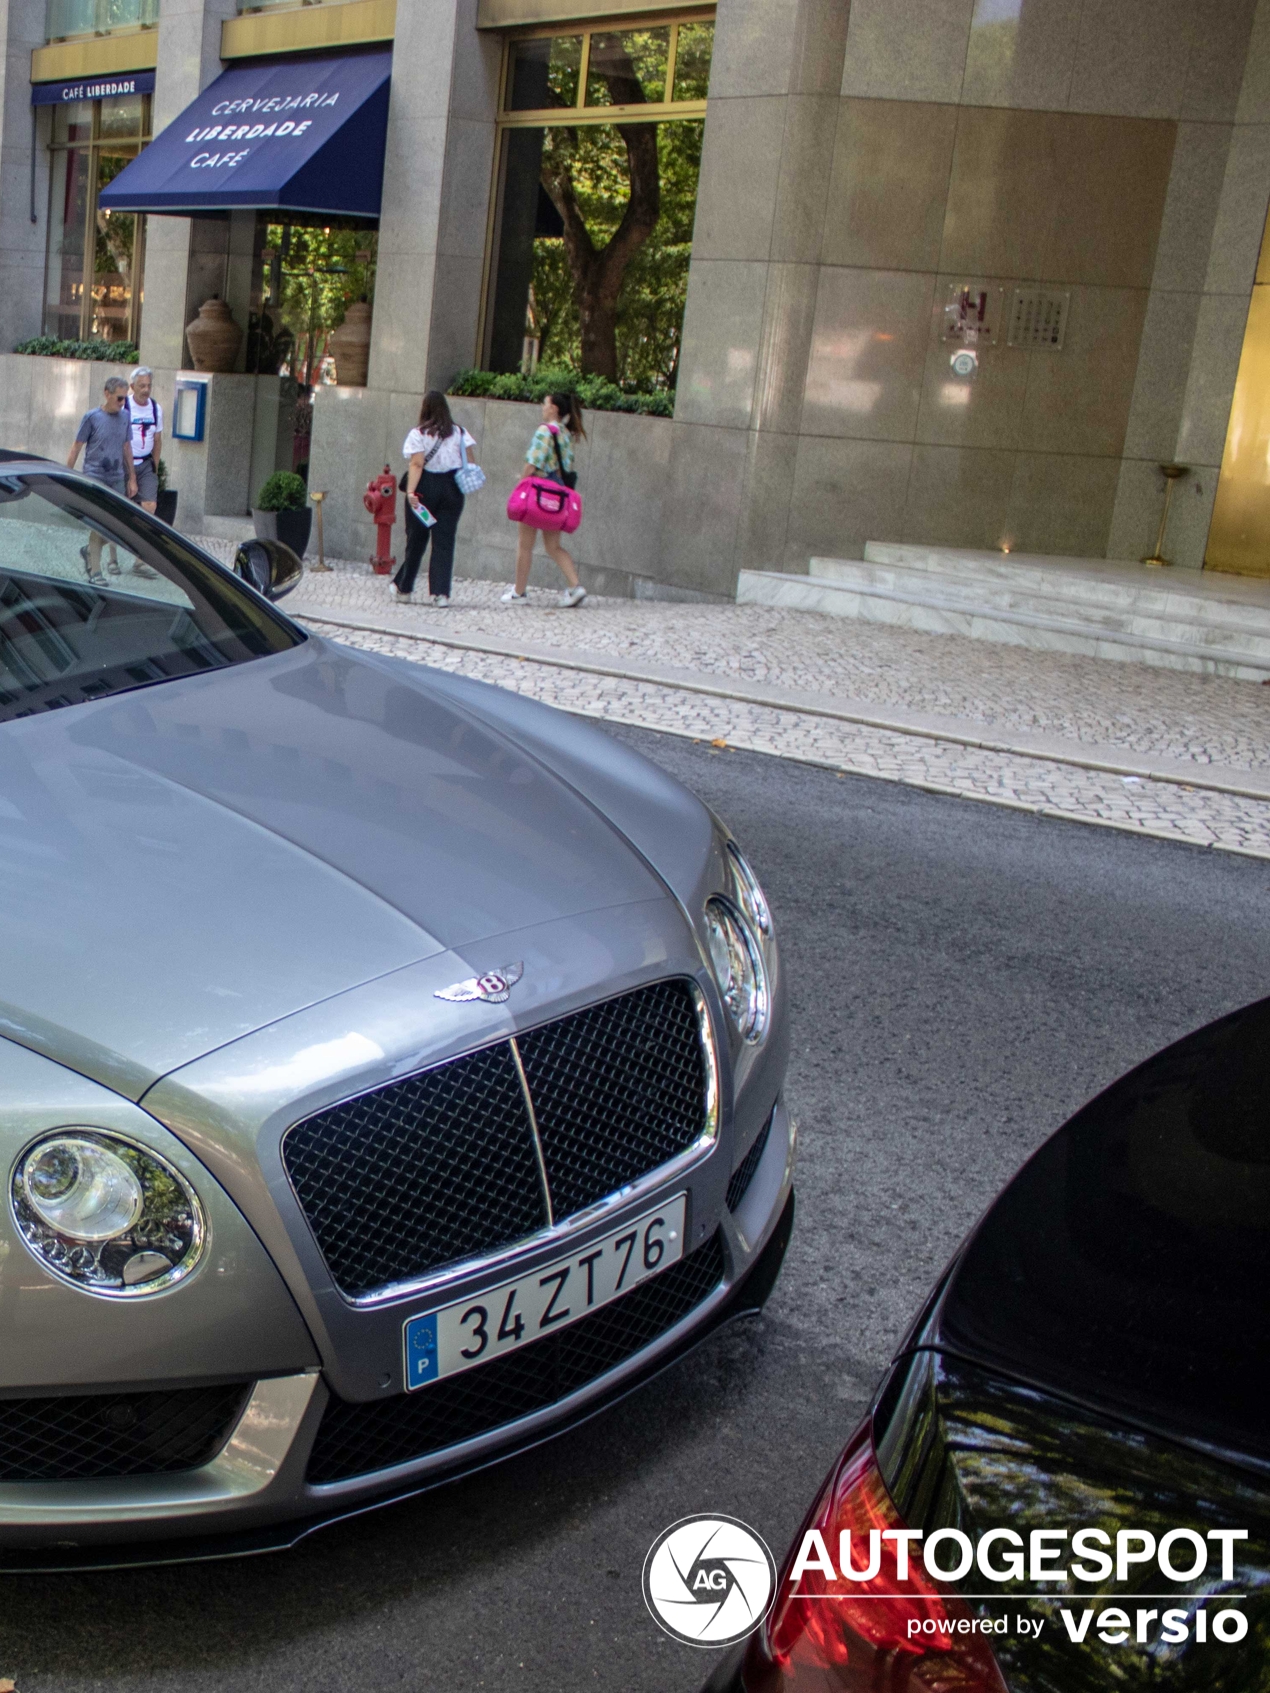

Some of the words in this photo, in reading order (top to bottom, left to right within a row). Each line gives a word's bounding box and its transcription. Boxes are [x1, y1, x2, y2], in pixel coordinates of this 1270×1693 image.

[63, 85, 84, 100] CAFÉ
[87, 81, 135, 97] LIBERDADE
[211, 92, 339, 115] CERVEJARIA
[185, 120, 312, 142] LIBERDADE
[190, 148, 249, 168] CAFÉ
[417, 1358, 430, 1374] P
